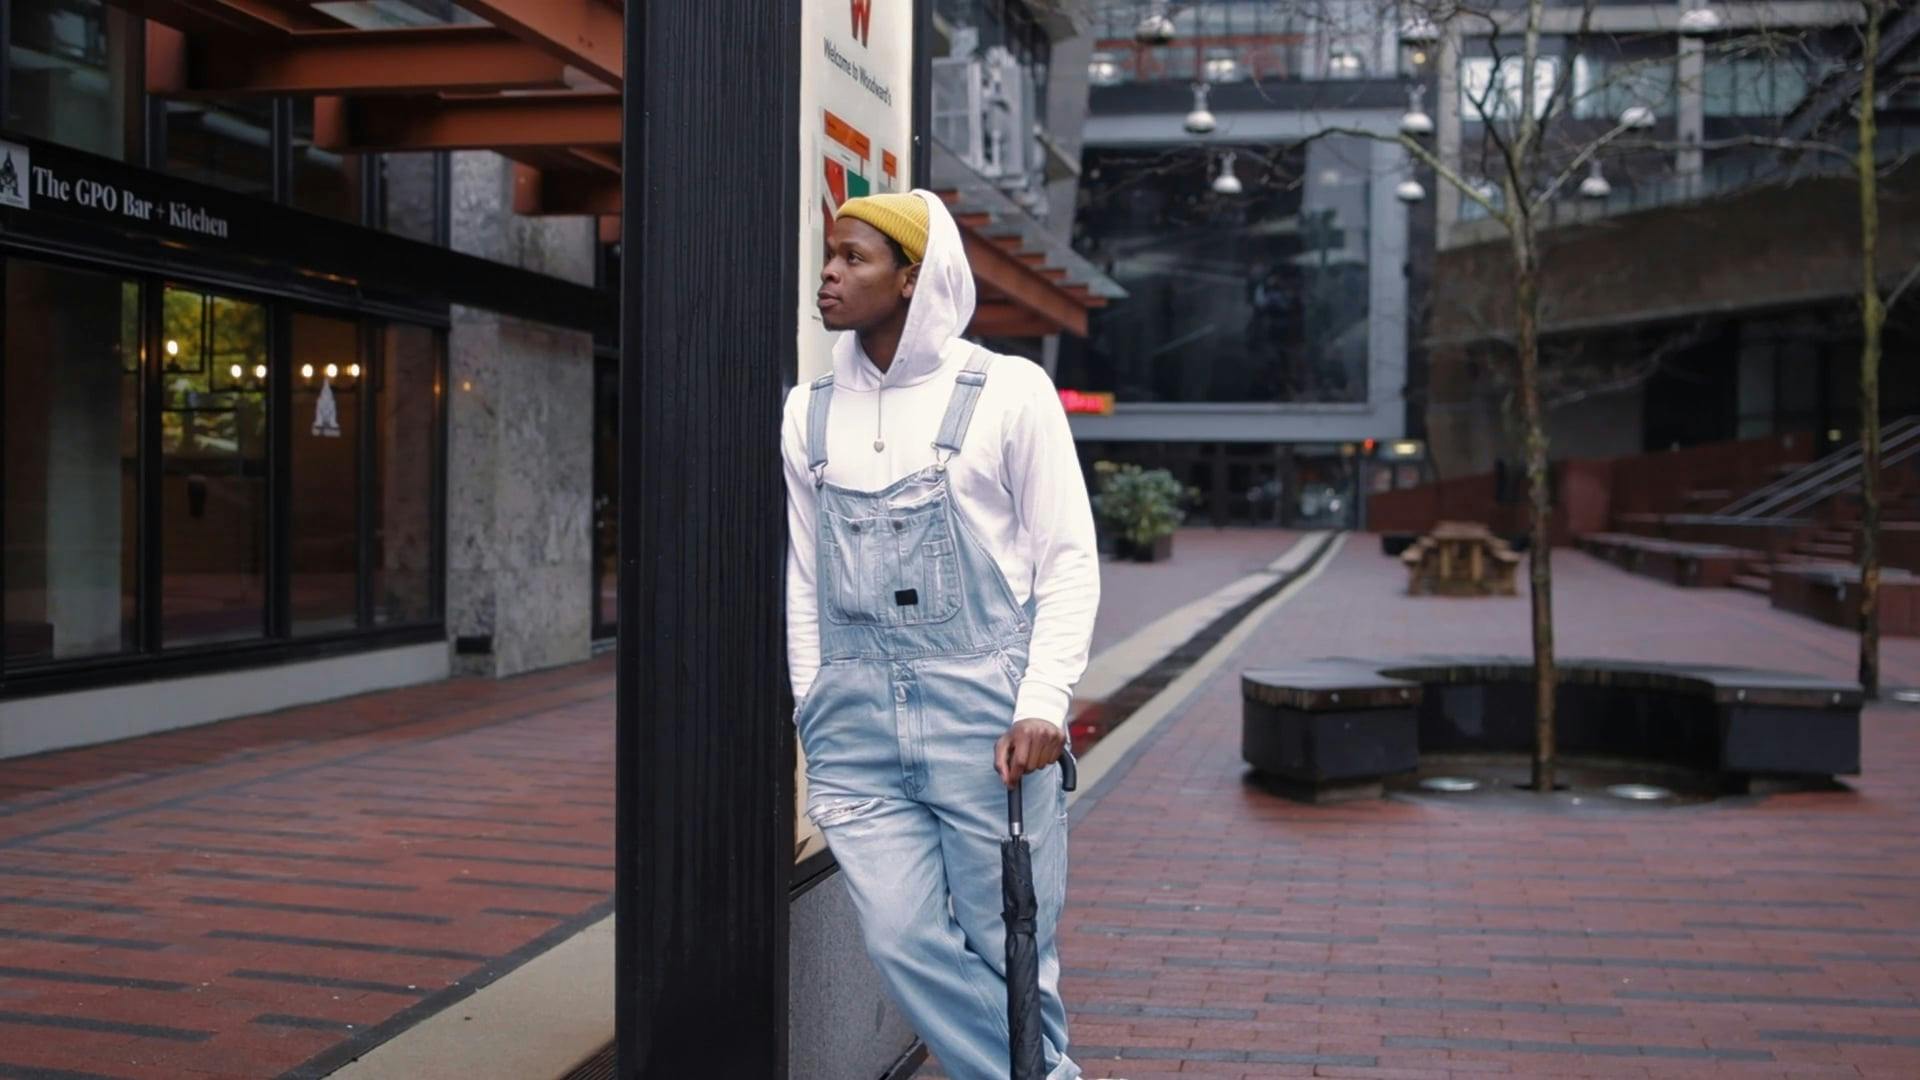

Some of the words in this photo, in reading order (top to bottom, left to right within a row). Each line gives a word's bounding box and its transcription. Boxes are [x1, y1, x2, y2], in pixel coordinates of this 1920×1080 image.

[824, 37, 852, 76] Welcome
[852, 61, 859, 82] to
[33, 166, 70, 201] The
[75, 178, 118, 211] GPO
[123, 190, 153, 220] Bar
[156, 202, 165, 219] +
[169, 201, 228, 238] Kitchen
